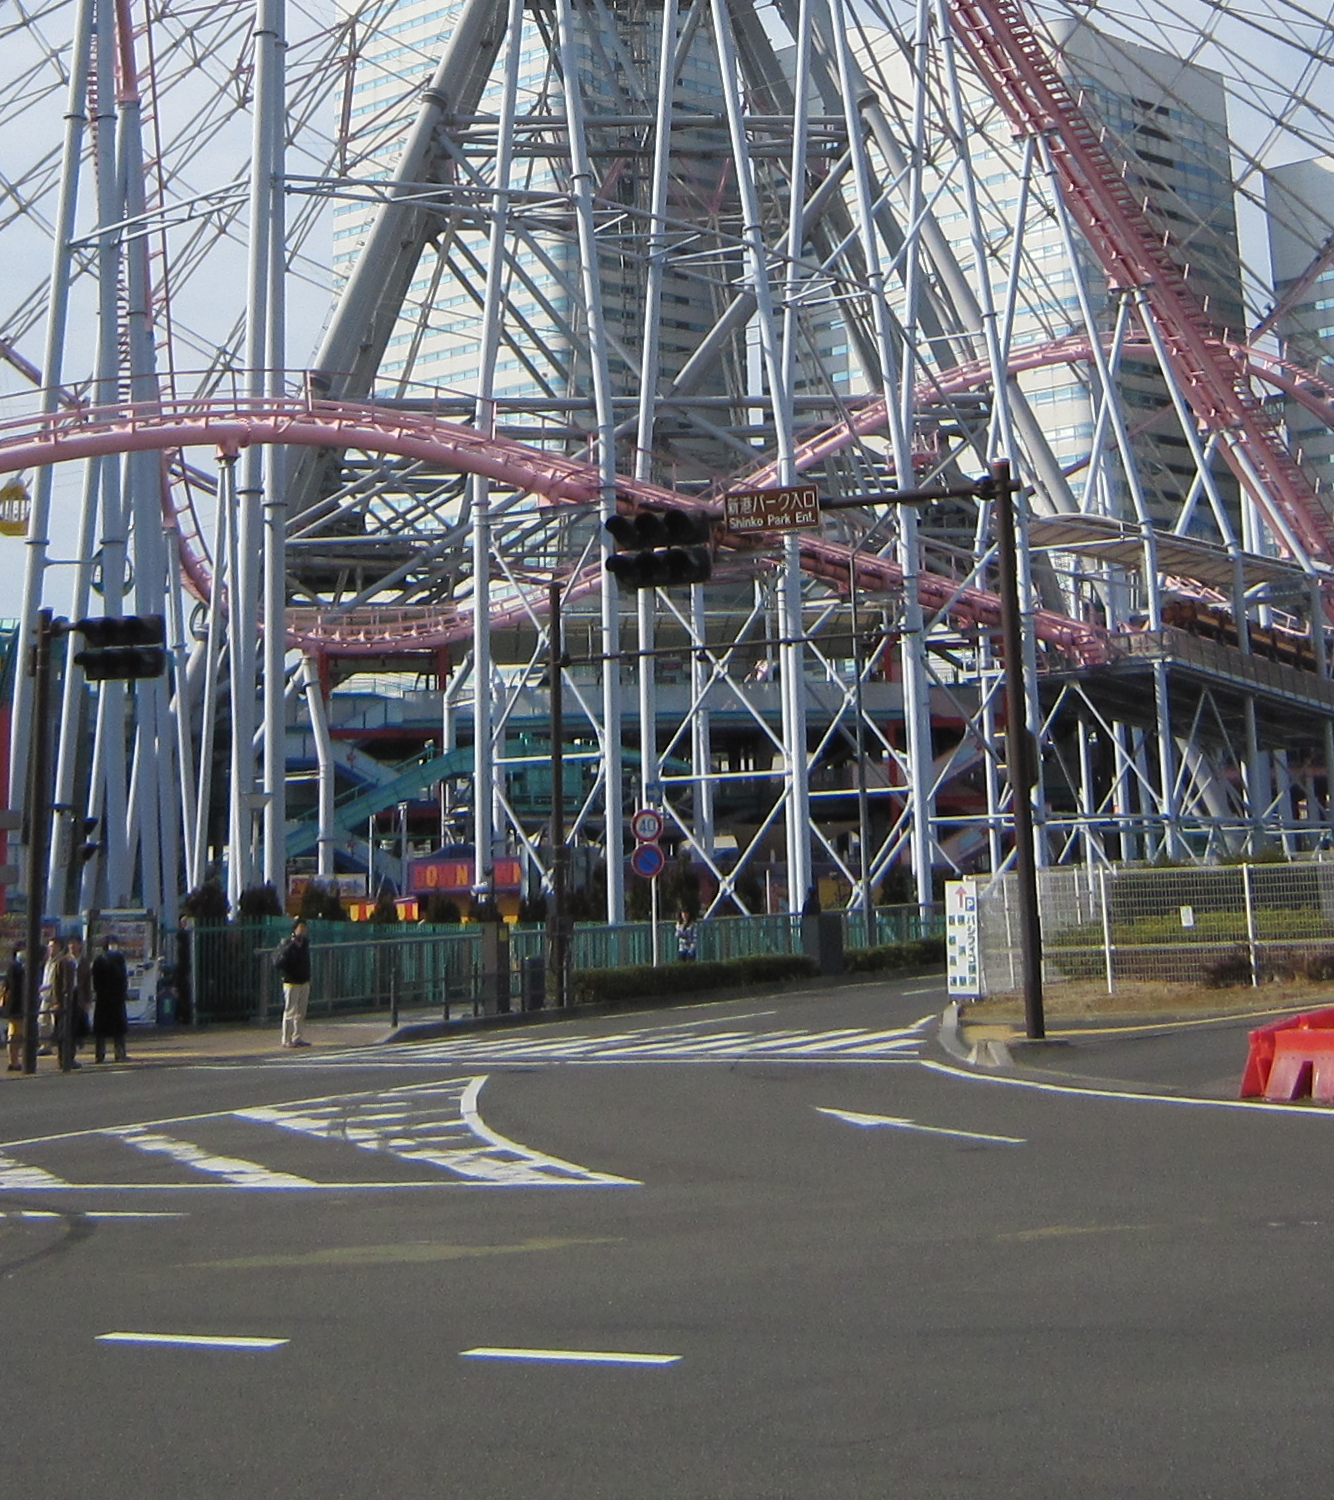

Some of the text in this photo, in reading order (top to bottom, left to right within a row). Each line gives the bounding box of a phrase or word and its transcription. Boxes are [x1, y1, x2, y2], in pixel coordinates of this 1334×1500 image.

[728, 491, 815, 515] 新港パーク入口
[729, 511, 816, 529] Shinko Park Ent.
[641, 818, 656, 833] 40
